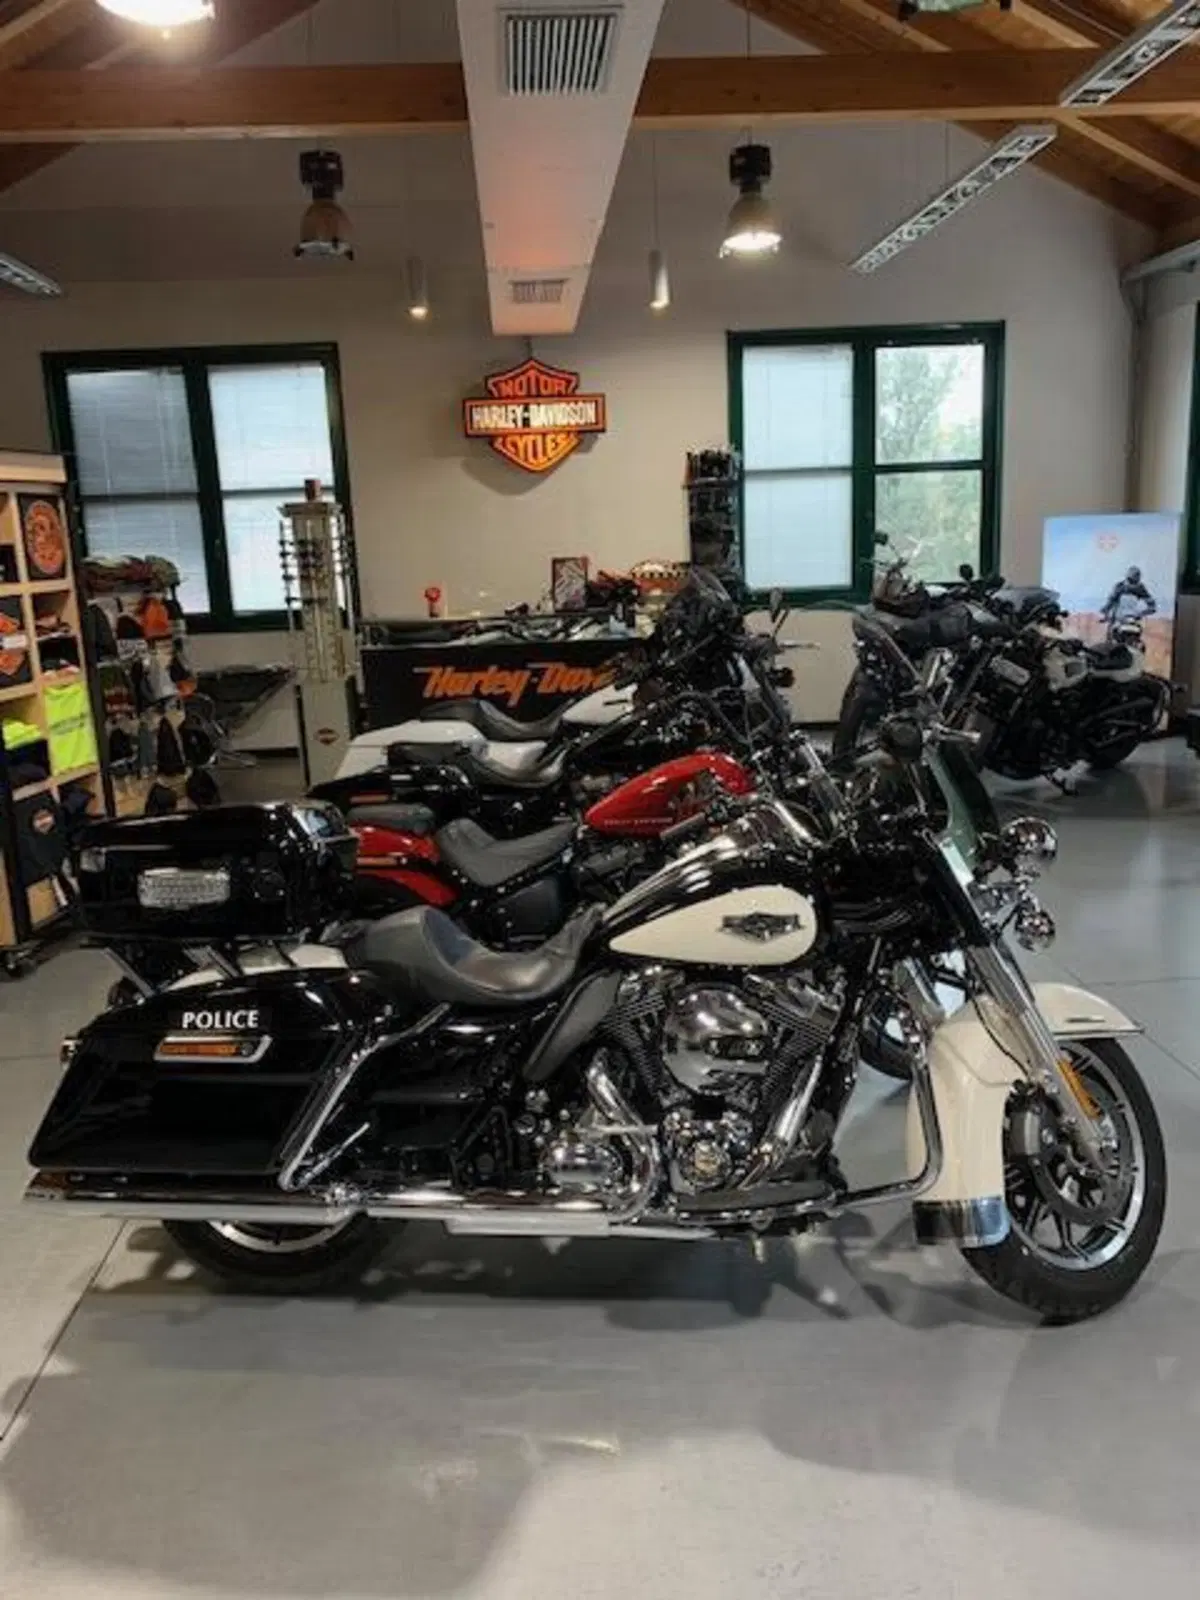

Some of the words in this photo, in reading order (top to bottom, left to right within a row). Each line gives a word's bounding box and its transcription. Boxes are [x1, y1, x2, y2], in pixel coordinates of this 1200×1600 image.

[500, 369, 567, 397] MOTOR
[472, 401, 597, 429] HARLEY-DAVIDSON
[182, 1009, 259, 1029] POLICE
